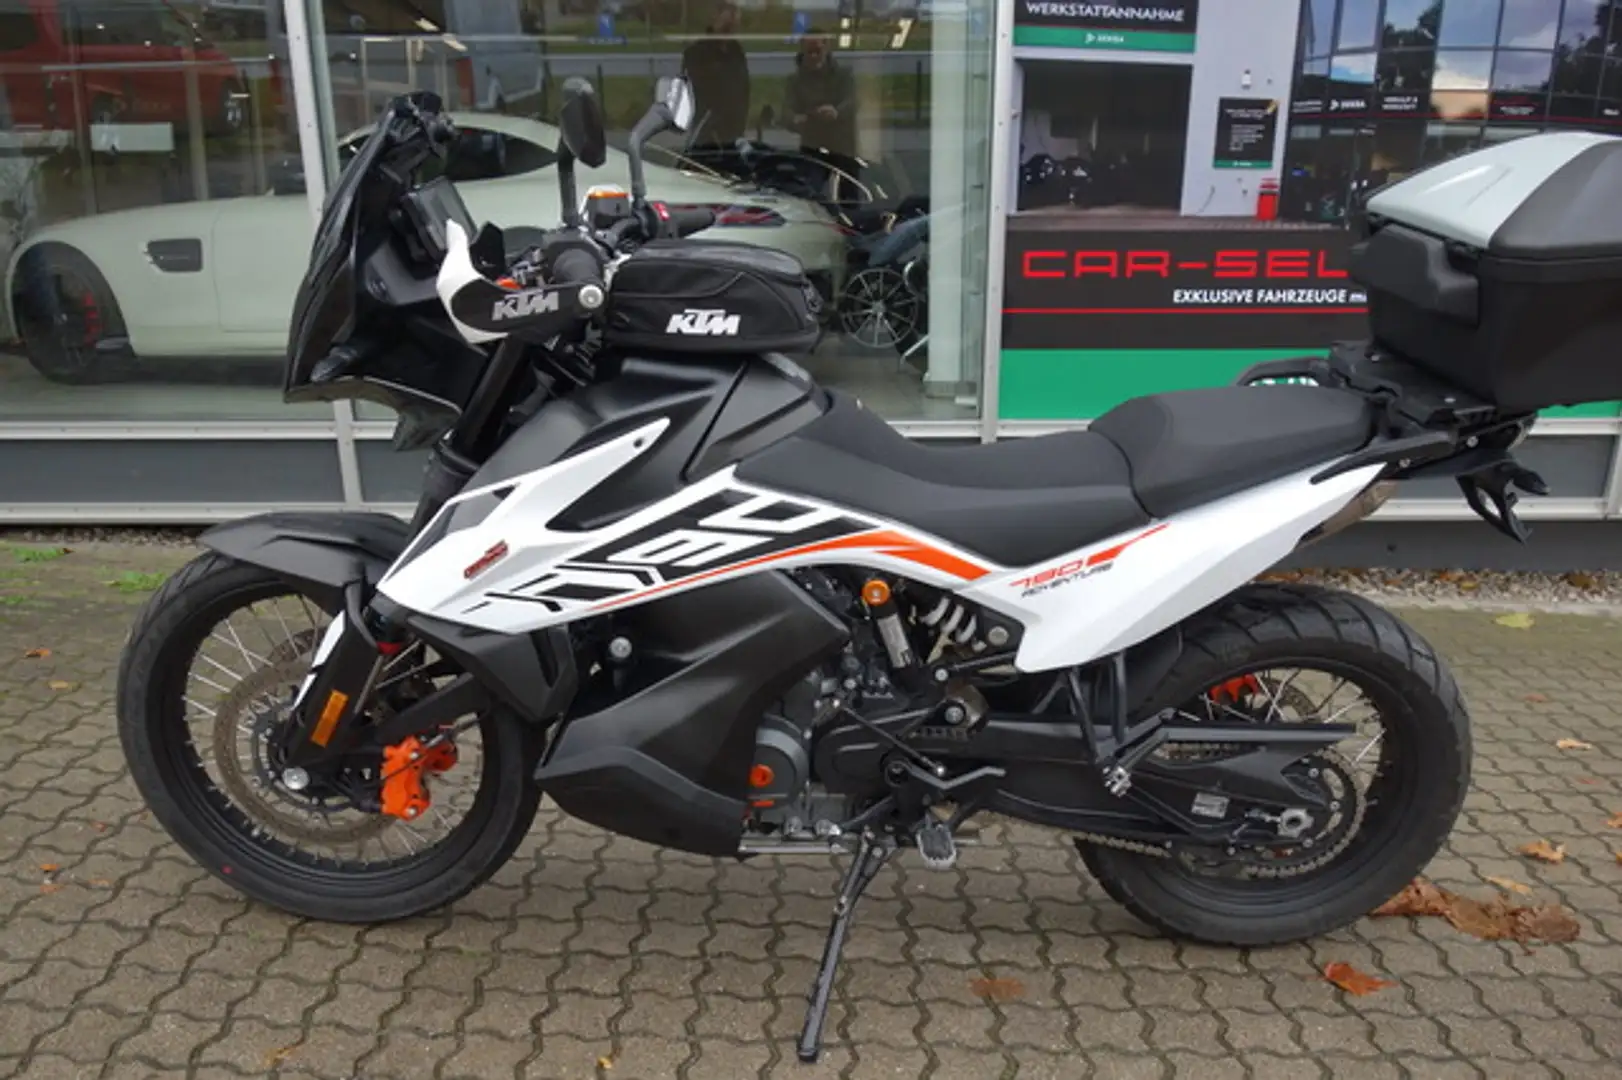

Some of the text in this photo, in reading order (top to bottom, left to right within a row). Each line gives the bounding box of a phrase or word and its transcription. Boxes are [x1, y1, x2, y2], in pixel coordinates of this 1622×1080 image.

[1025, 2, 1185, 22] WERKSTATTANNAHME
[492, 289, 559, 321] KTM
[1172, 288, 1253, 303] EXKLUSIVE
[1256, 289, 1347, 304] FAHRZEUGE
[665, 308, 741, 336] KTM
